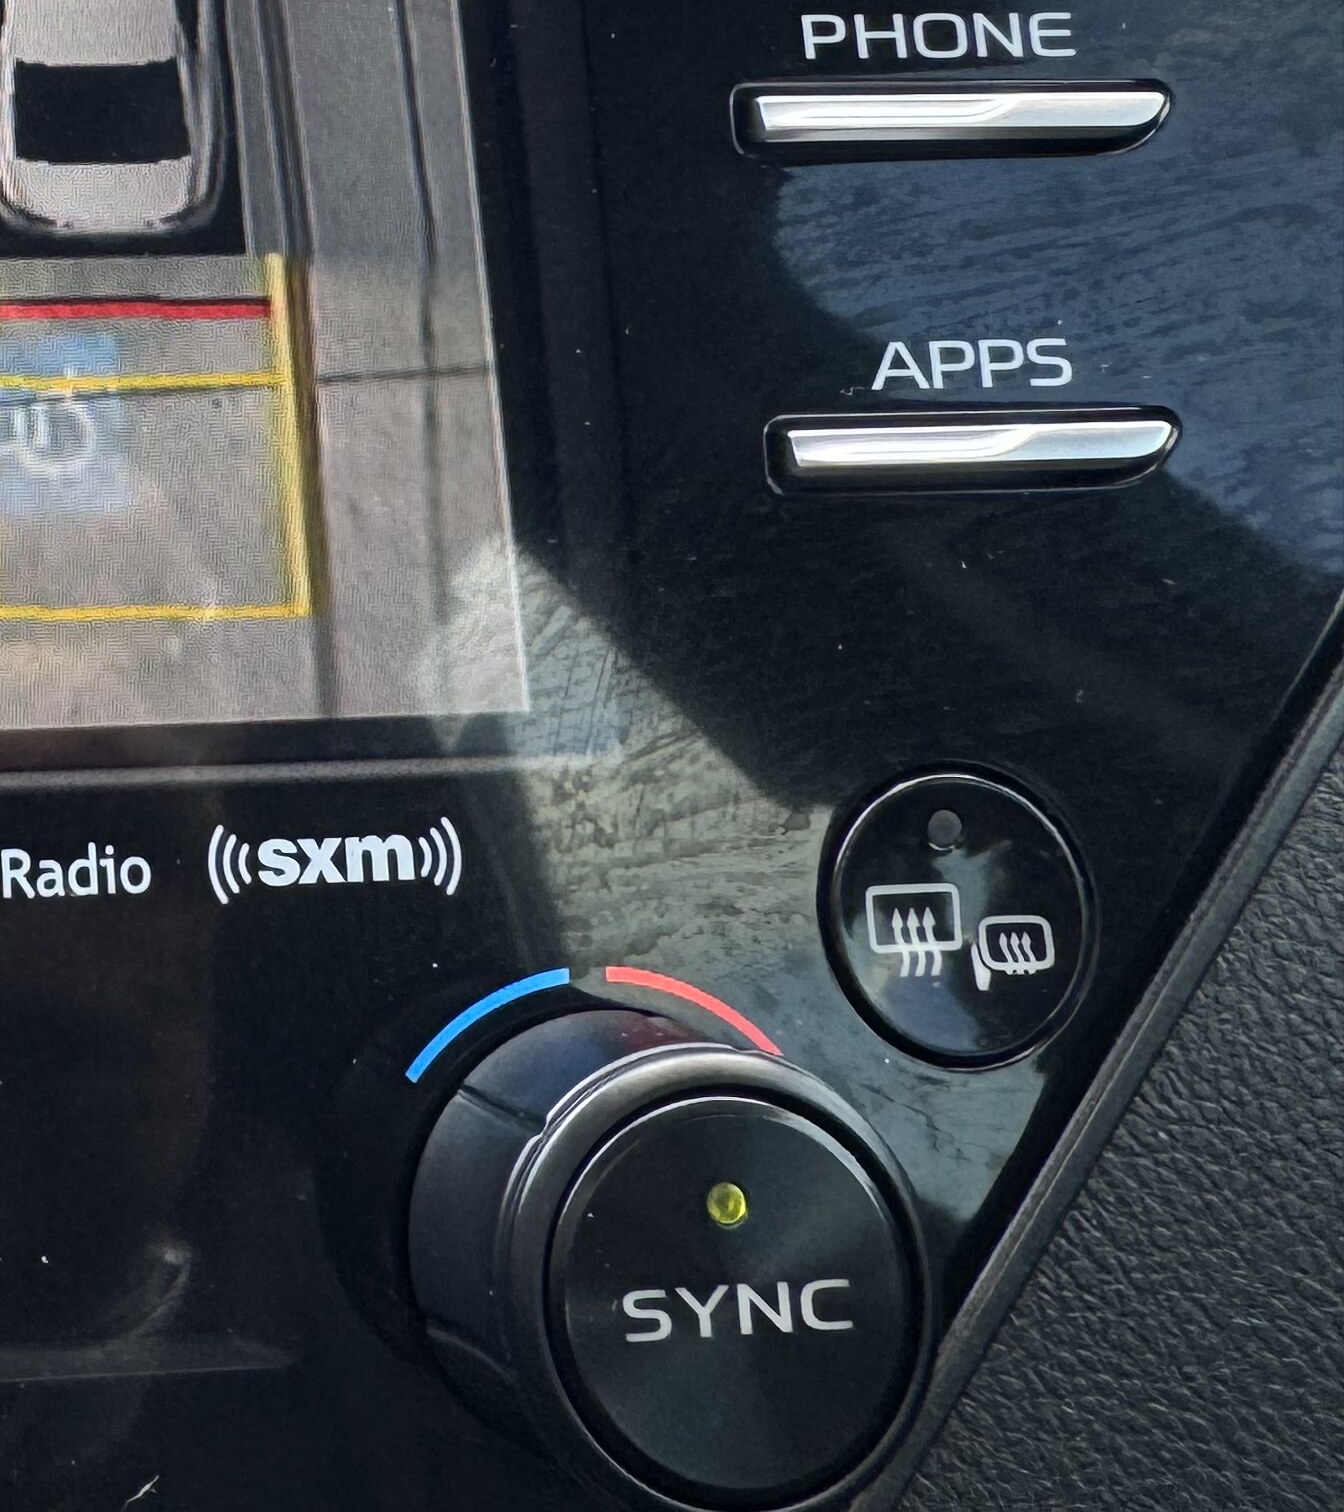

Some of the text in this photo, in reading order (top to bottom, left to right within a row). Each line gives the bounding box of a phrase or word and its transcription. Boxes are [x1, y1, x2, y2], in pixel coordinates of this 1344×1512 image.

[800, 12, 1077, 60] PHONE
[871, 338, 1073, 391] APPS
[0, 842, 152, 899] Radio
[621, 1278, 854, 1342] SYNC
